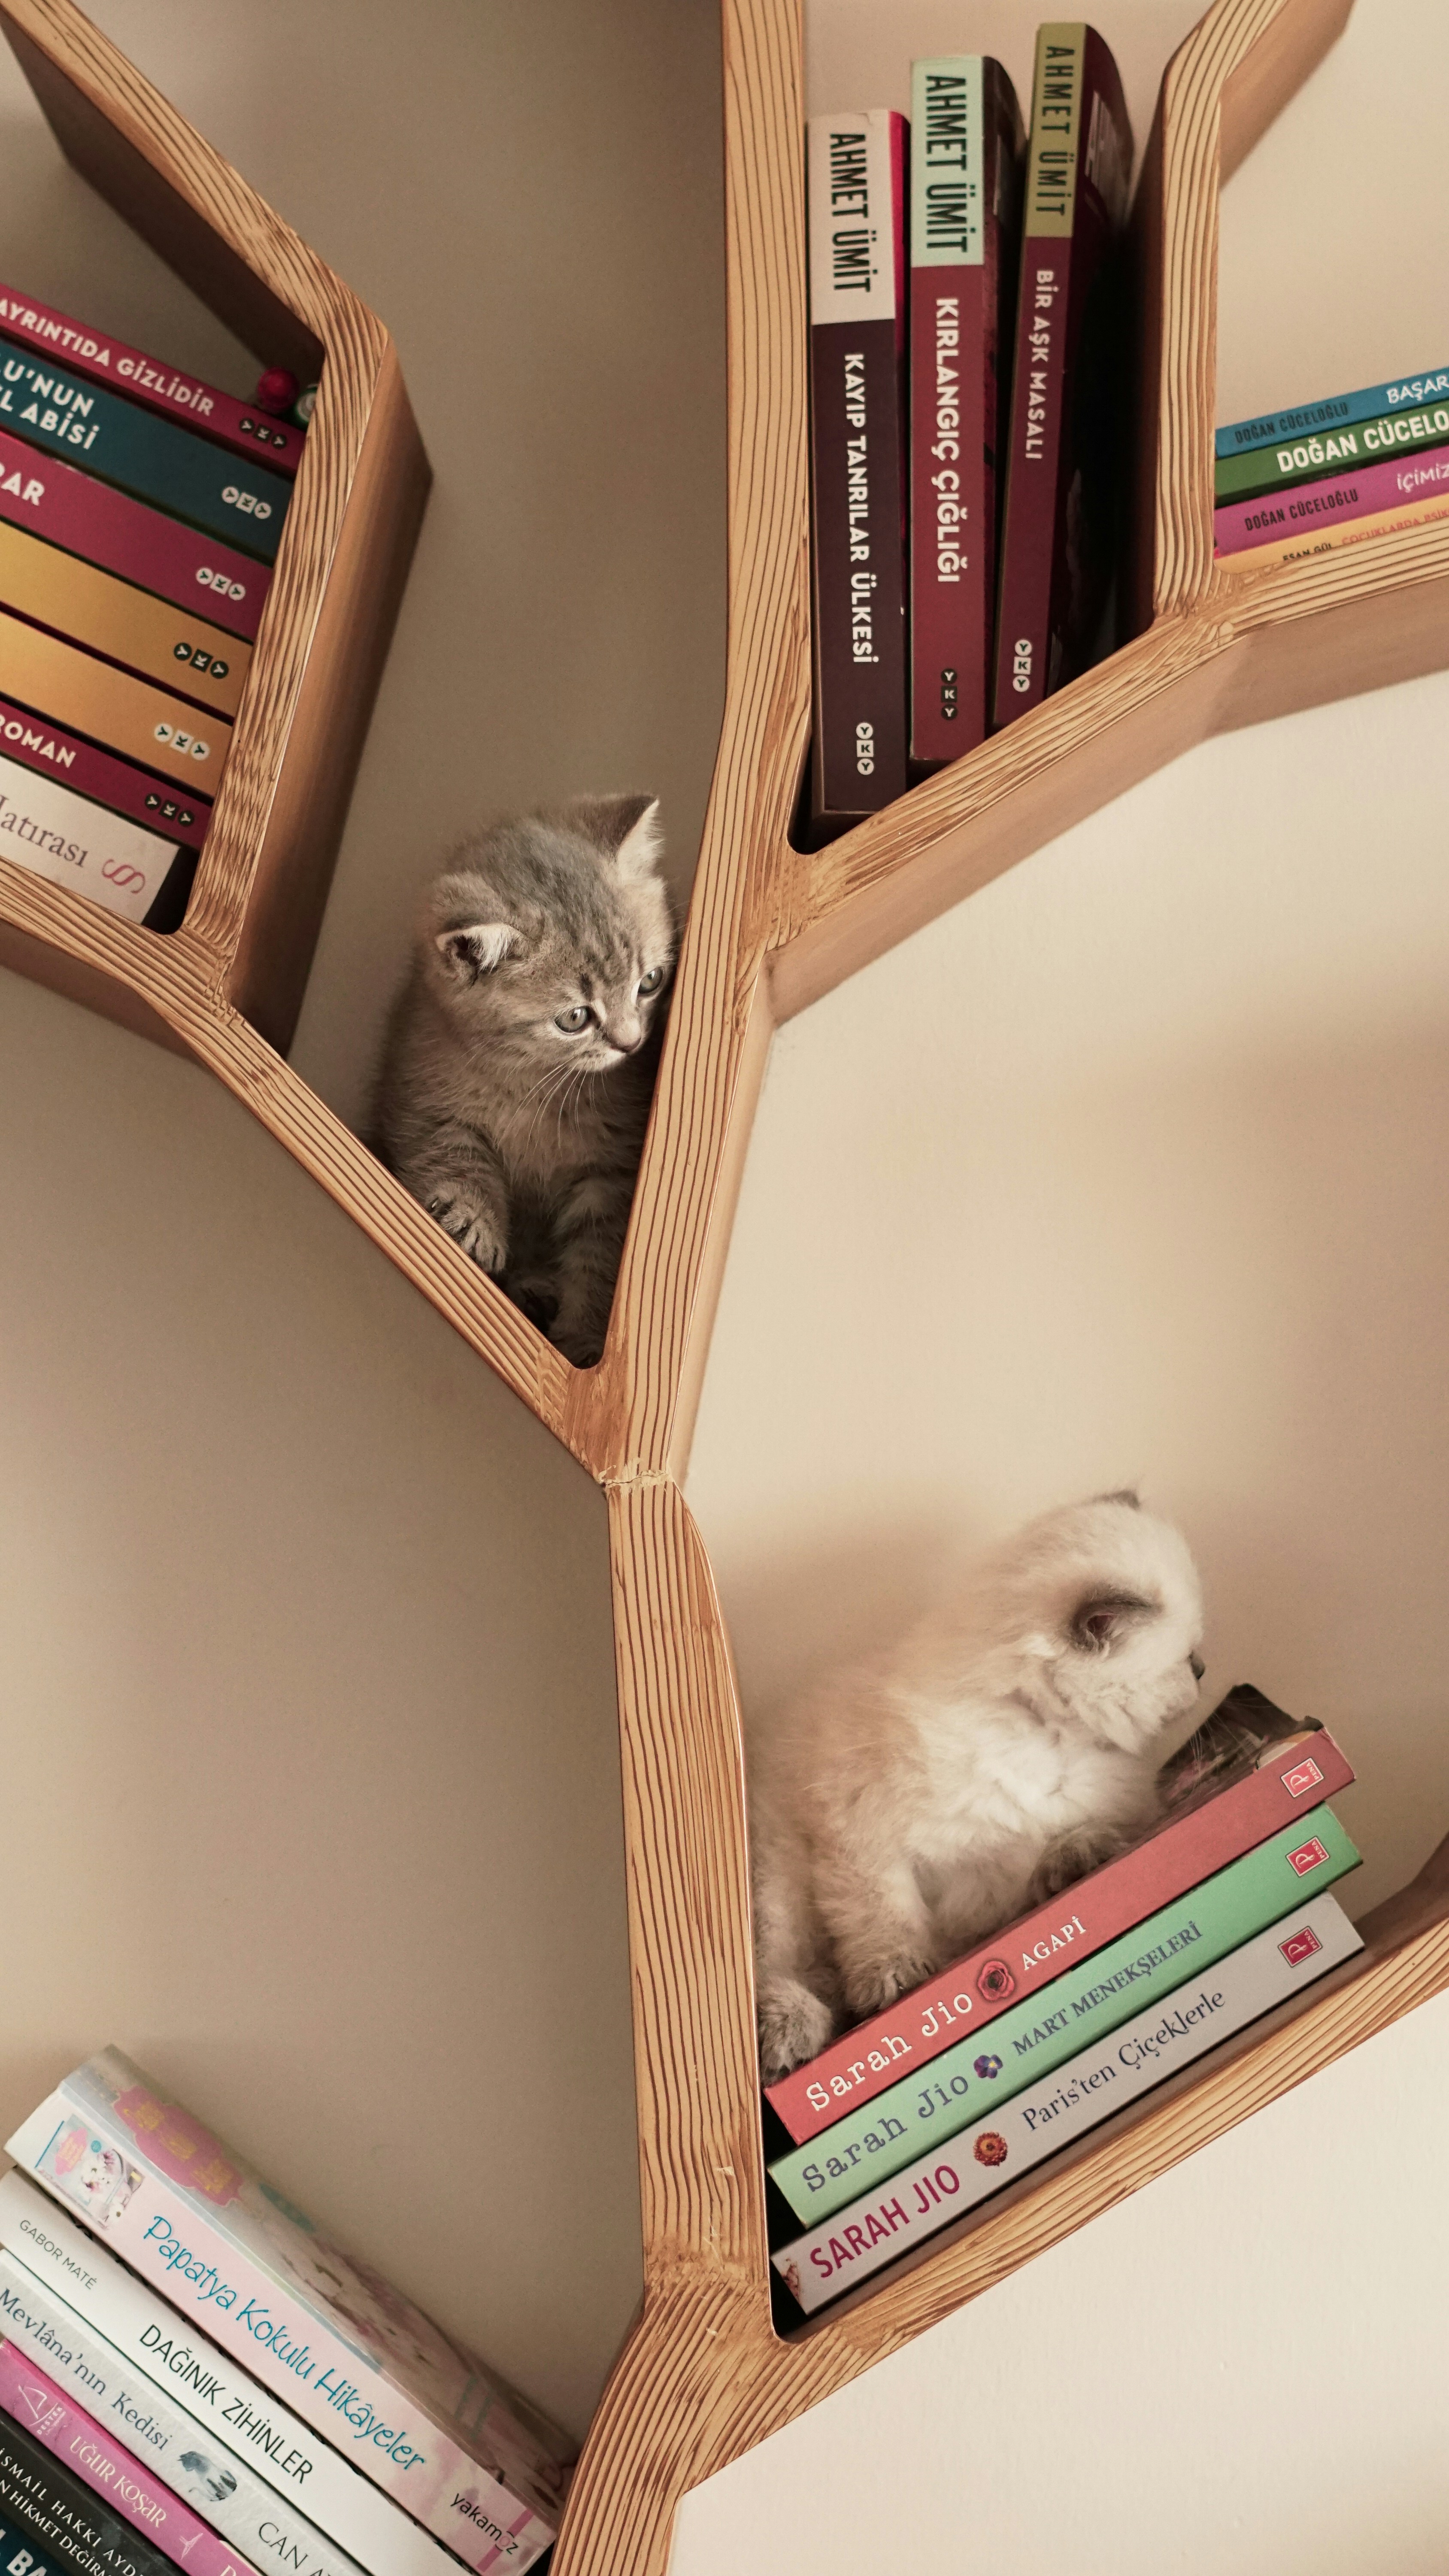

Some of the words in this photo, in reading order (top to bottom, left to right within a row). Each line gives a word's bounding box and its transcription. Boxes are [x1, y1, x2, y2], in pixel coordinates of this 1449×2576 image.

[1040, 46, 1075, 135] AHMET
[926, 75, 967, 171] AHMET
[830, 133, 868, 219] AHMET
[1036, 151, 1075, 216] ÜMİT
[926, 182, 976, 253] ÜMİT
[832, 229, 877, 293] ÜMİT
[1035, 269, 1059, 308] BİR
[1029, 316, 1050, 363] AŞK
[116, 358, 215, 416] GİZLİDİR
[844, 353, 867, 428] KAYIP
[931, 298, 960, 462] KIRLANGIÇ
[20, 402, 100, 450] ABİSİ
[239, 418, 287, 450] YKY
[1025, 372, 1046, 460] MASALI
[1234, 425, 1275, 444] DOĞAN
[1276, 433, 1358, 472] DOĞAN
[1363, 410, 1449, 450] CÜCELO
[222, 486, 272, 519] YKY
[847, 435, 870, 562] TANRILAR
[931, 471, 968, 583] ÇIĞLIĞI
[1245, 509, 1285, 531] DOĞAN
[1289, 489, 1358, 519] CÜCELOĞLU
[196, 568, 246, 600] YKY
[850, 572, 879, 663] ÜLKESİ
[174, 642, 230, 679] YKY
[1012, 639, 1033, 692] YKY
[940, 668, 958, 720] YKY
[154, 723, 210, 760] YKY
[856, 722, 874, 775] YKY
[145, 793, 195, 827] YKY
[1307, 1762, 1319, 1780] PENA
[1312, 1841, 1325, 1859] PENA
[806, 2035, 912, 2112] Sarah
[921, 1992, 973, 2037] Jio
[1021, 1915, 1087, 1971] AGAPİ
[802, 2114, 908, 2193] Sarah
[918, 2074, 970, 2118] Jio
[1011, 2008, 1069, 2057] MART
[1070, 1920, 1203, 2017] MENEKŞELERİ
[810, 2197, 910, 2279] SARAH
[916, 2165, 961, 2214] JIO
[1021, 2065, 1118, 2131] Paris'ten
[1118, 1988, 1225, 2069] Çiçeklerle
[20, 2220, 63, 2261] GABOR
[61, 2256, 97, 2290] MATÉ
[0, 2289, 107, 2397] Mevlâna'nın
[111, 2391, 173, 2451] Kedisi
[143, 2215, 237, 2309] Papatya
[236, 2299, 315, 2379] Kokulu
[314, 2368, 425, 2470] Hikâyeler
[139, 2324, 226, 2406] DAĞINIK
[221, 2397, 313, 2484] ZİHİNLER
[70, 2436, 116, 2482] UĞUR
[9, 2491, 62, 2538] HİKMET
[51, 2500, 102, 2548] HAKKI
[103, 2549, 143, 2576] AYD
[450, 2493, 519, 2555] yakamoz
[258, 2522, 309, 2570] CAN
